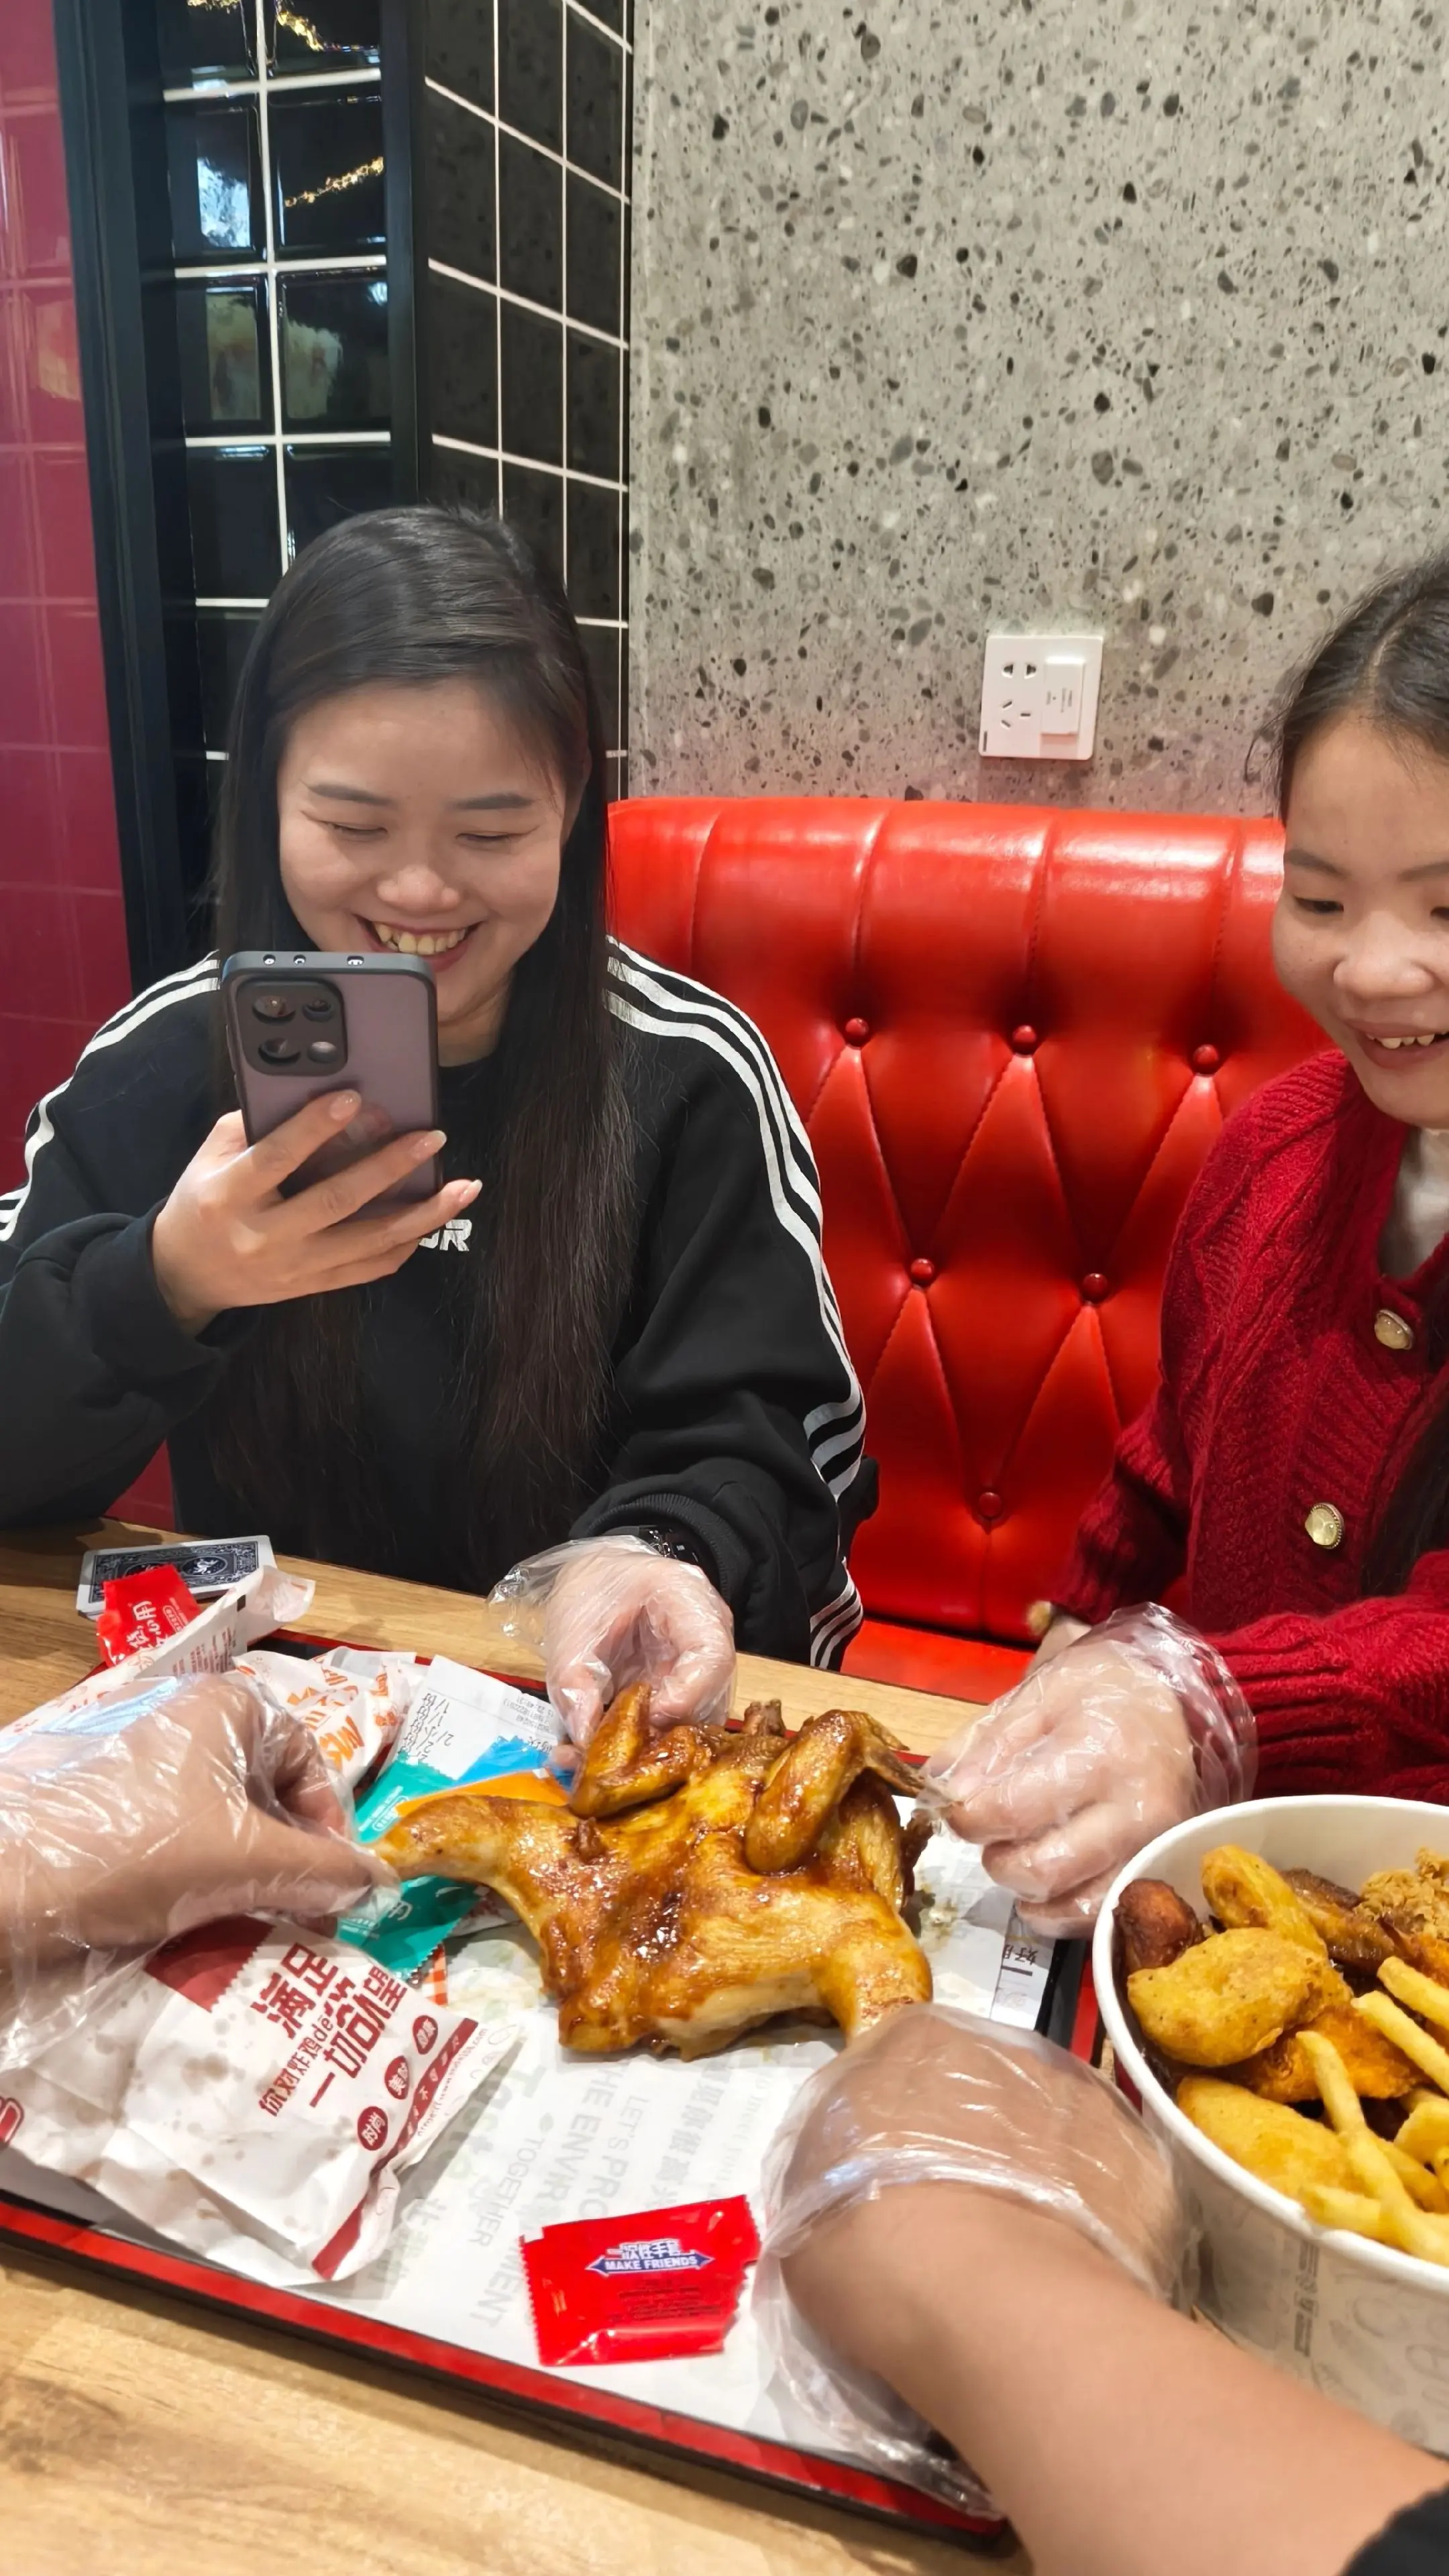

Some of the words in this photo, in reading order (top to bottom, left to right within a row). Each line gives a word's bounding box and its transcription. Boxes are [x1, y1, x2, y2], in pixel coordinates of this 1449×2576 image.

[250, 1943, 339, 2039] 满足
[309, 1964, 408, 2108] 一切欲望
[360, 2112, 386, 2146] 时尚
[608, 2094, 651, 2151] LET'S
[468, 2137, 545, 2247] TOGETHER
[578, 2155, 629, 2218] PRO
[605, 2259, 642, 2271] MAKE
[644, 2255, 698, 2269] FRIENDS
